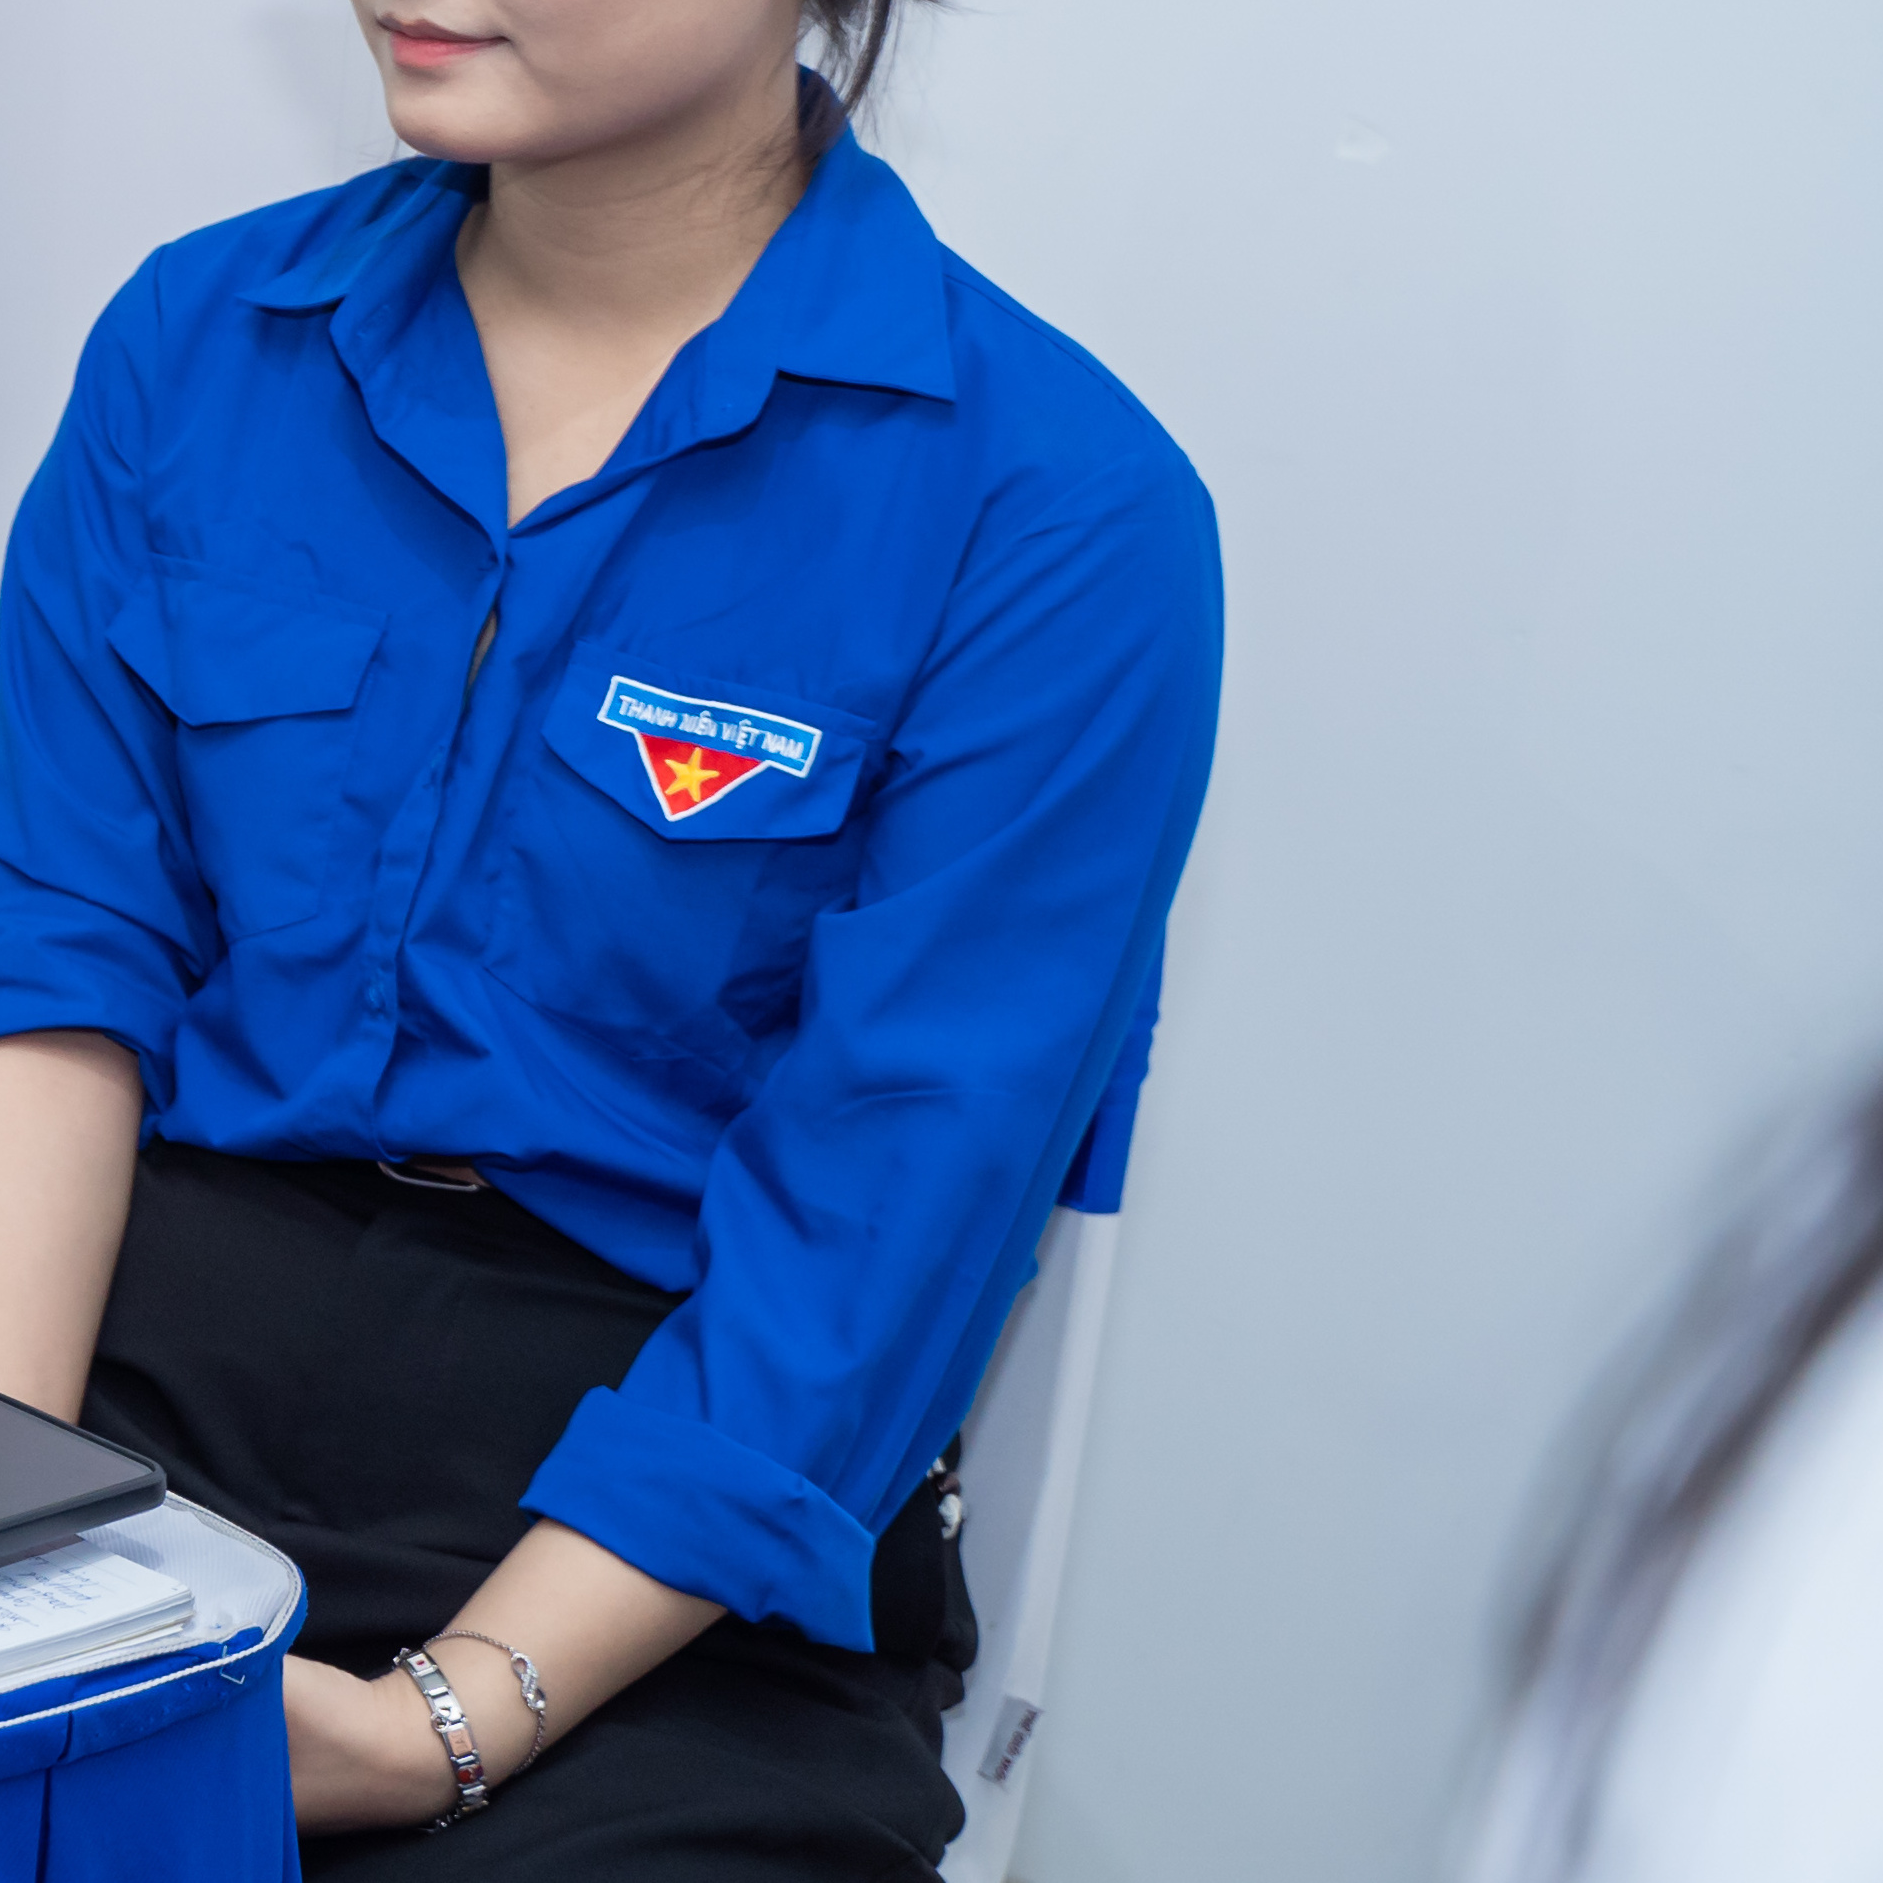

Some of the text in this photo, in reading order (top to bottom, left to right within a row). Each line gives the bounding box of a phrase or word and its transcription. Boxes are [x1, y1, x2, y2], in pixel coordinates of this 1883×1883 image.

[618, 694, 678, 728] THANH
[720, 718, 763, 749] VIỆT
[761, 729, 805, 760] NAM
